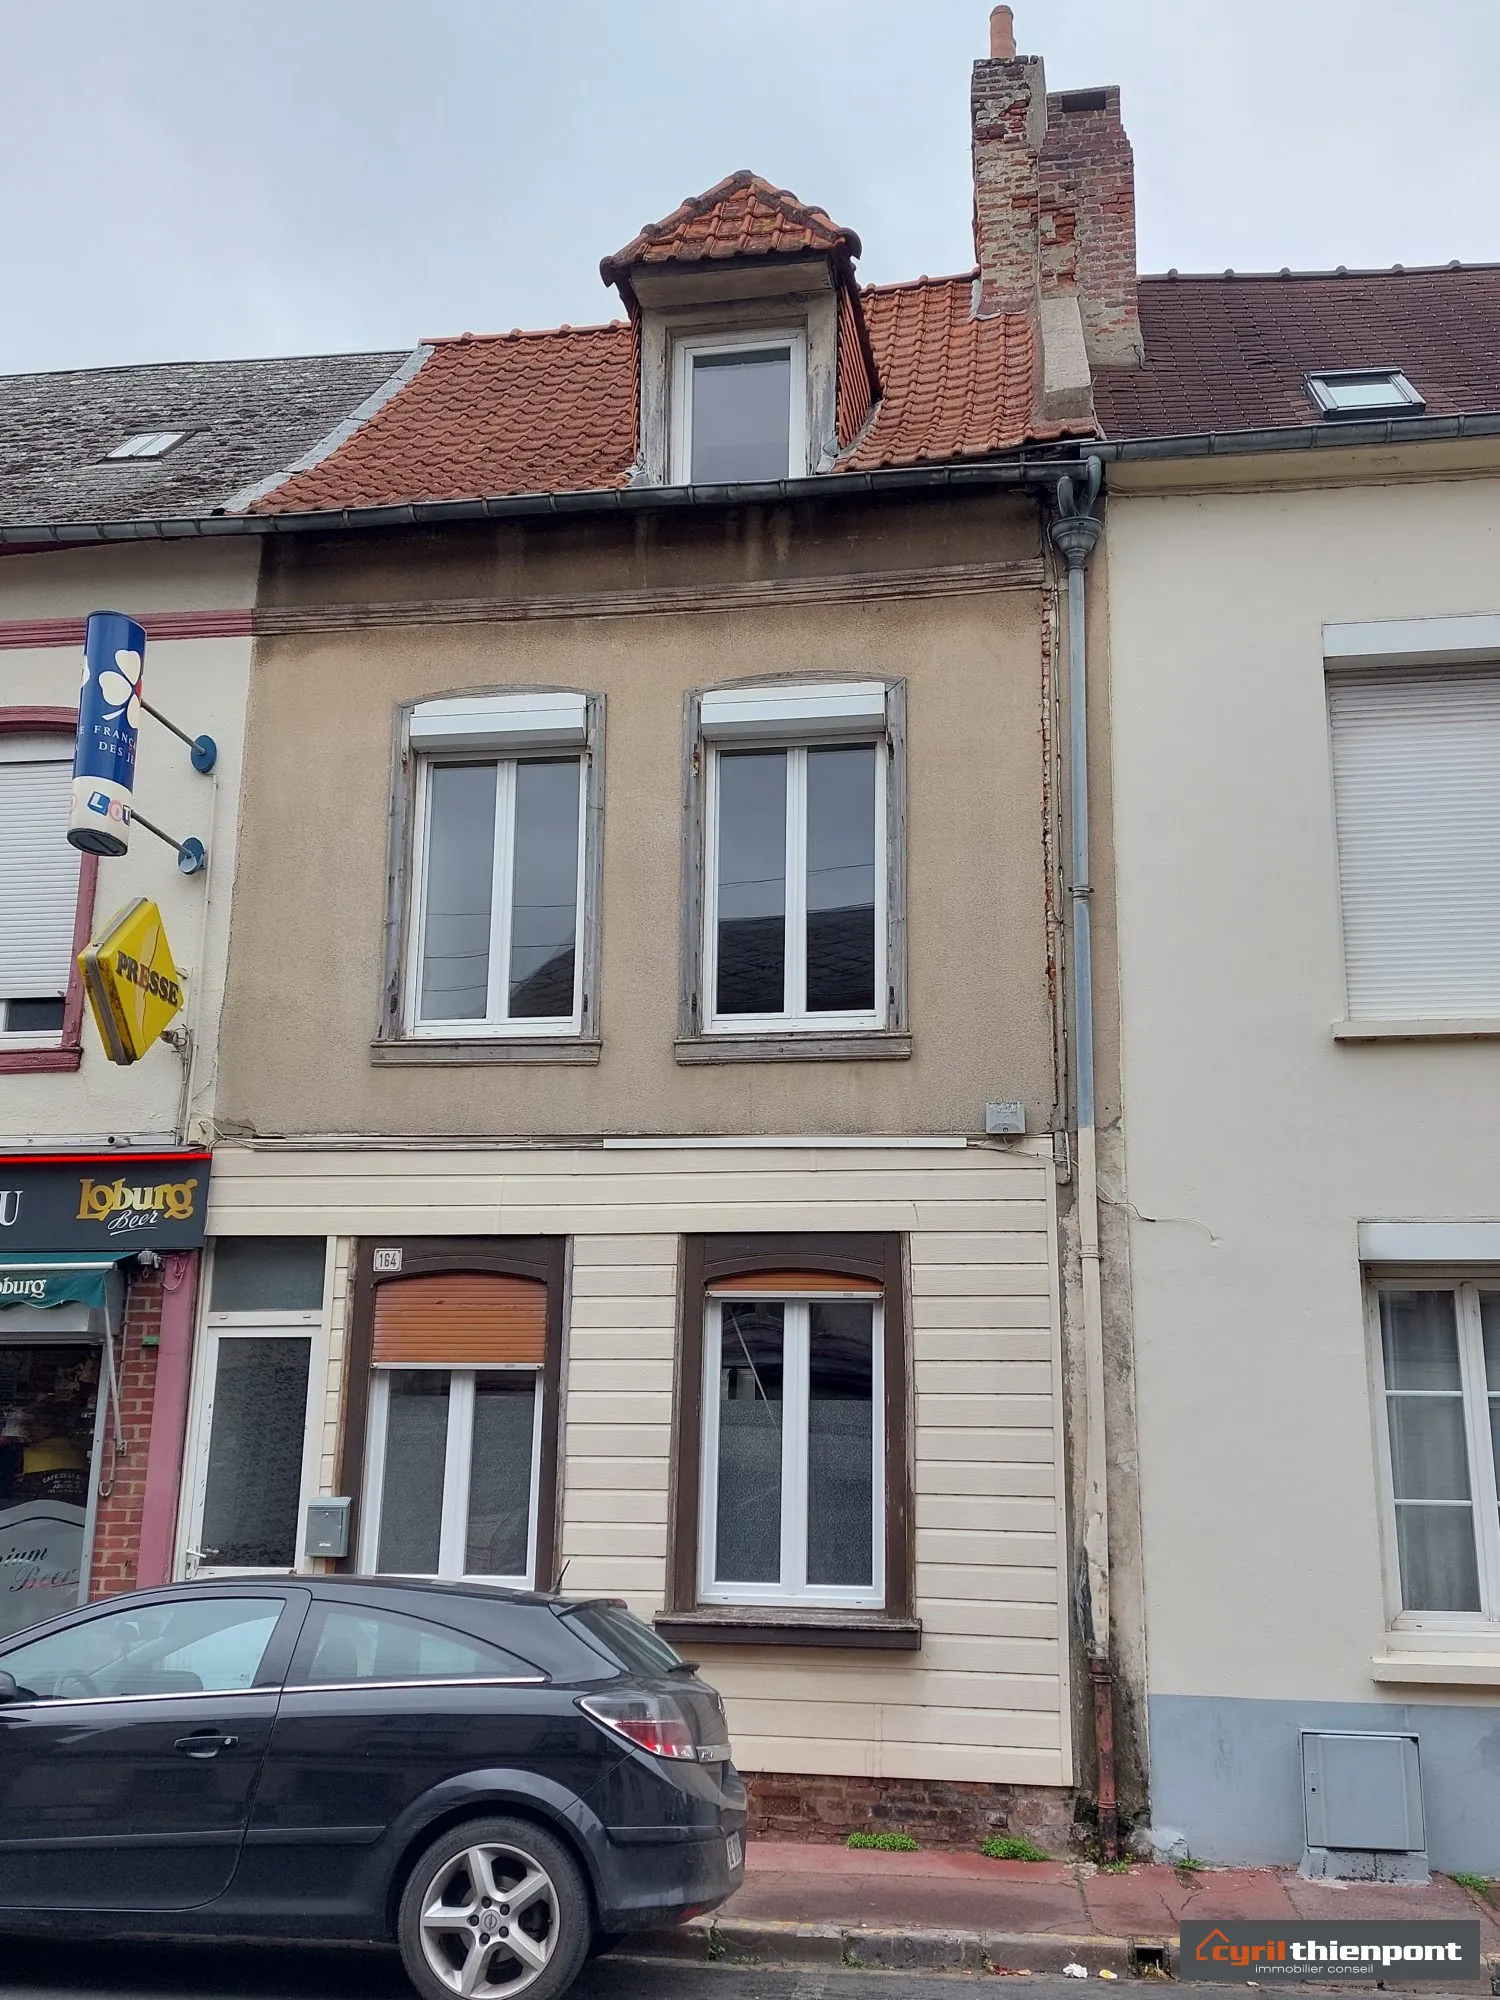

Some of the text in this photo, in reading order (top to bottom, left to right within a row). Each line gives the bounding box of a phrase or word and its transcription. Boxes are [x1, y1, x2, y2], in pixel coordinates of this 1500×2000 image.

[99, 741, 123, 757] DES
[116, 950, 179, 1008] PRESSE
[76, 1178, 198, 1222] Loburg
[107, 1209, 159, 1232] Beer
[379, 1252, 397, 1268] 164
[0, 1276, 47, 1299] burg
[0, 1547, 48, 1566] ium
[9, 1563, 78, 1593] Beer
